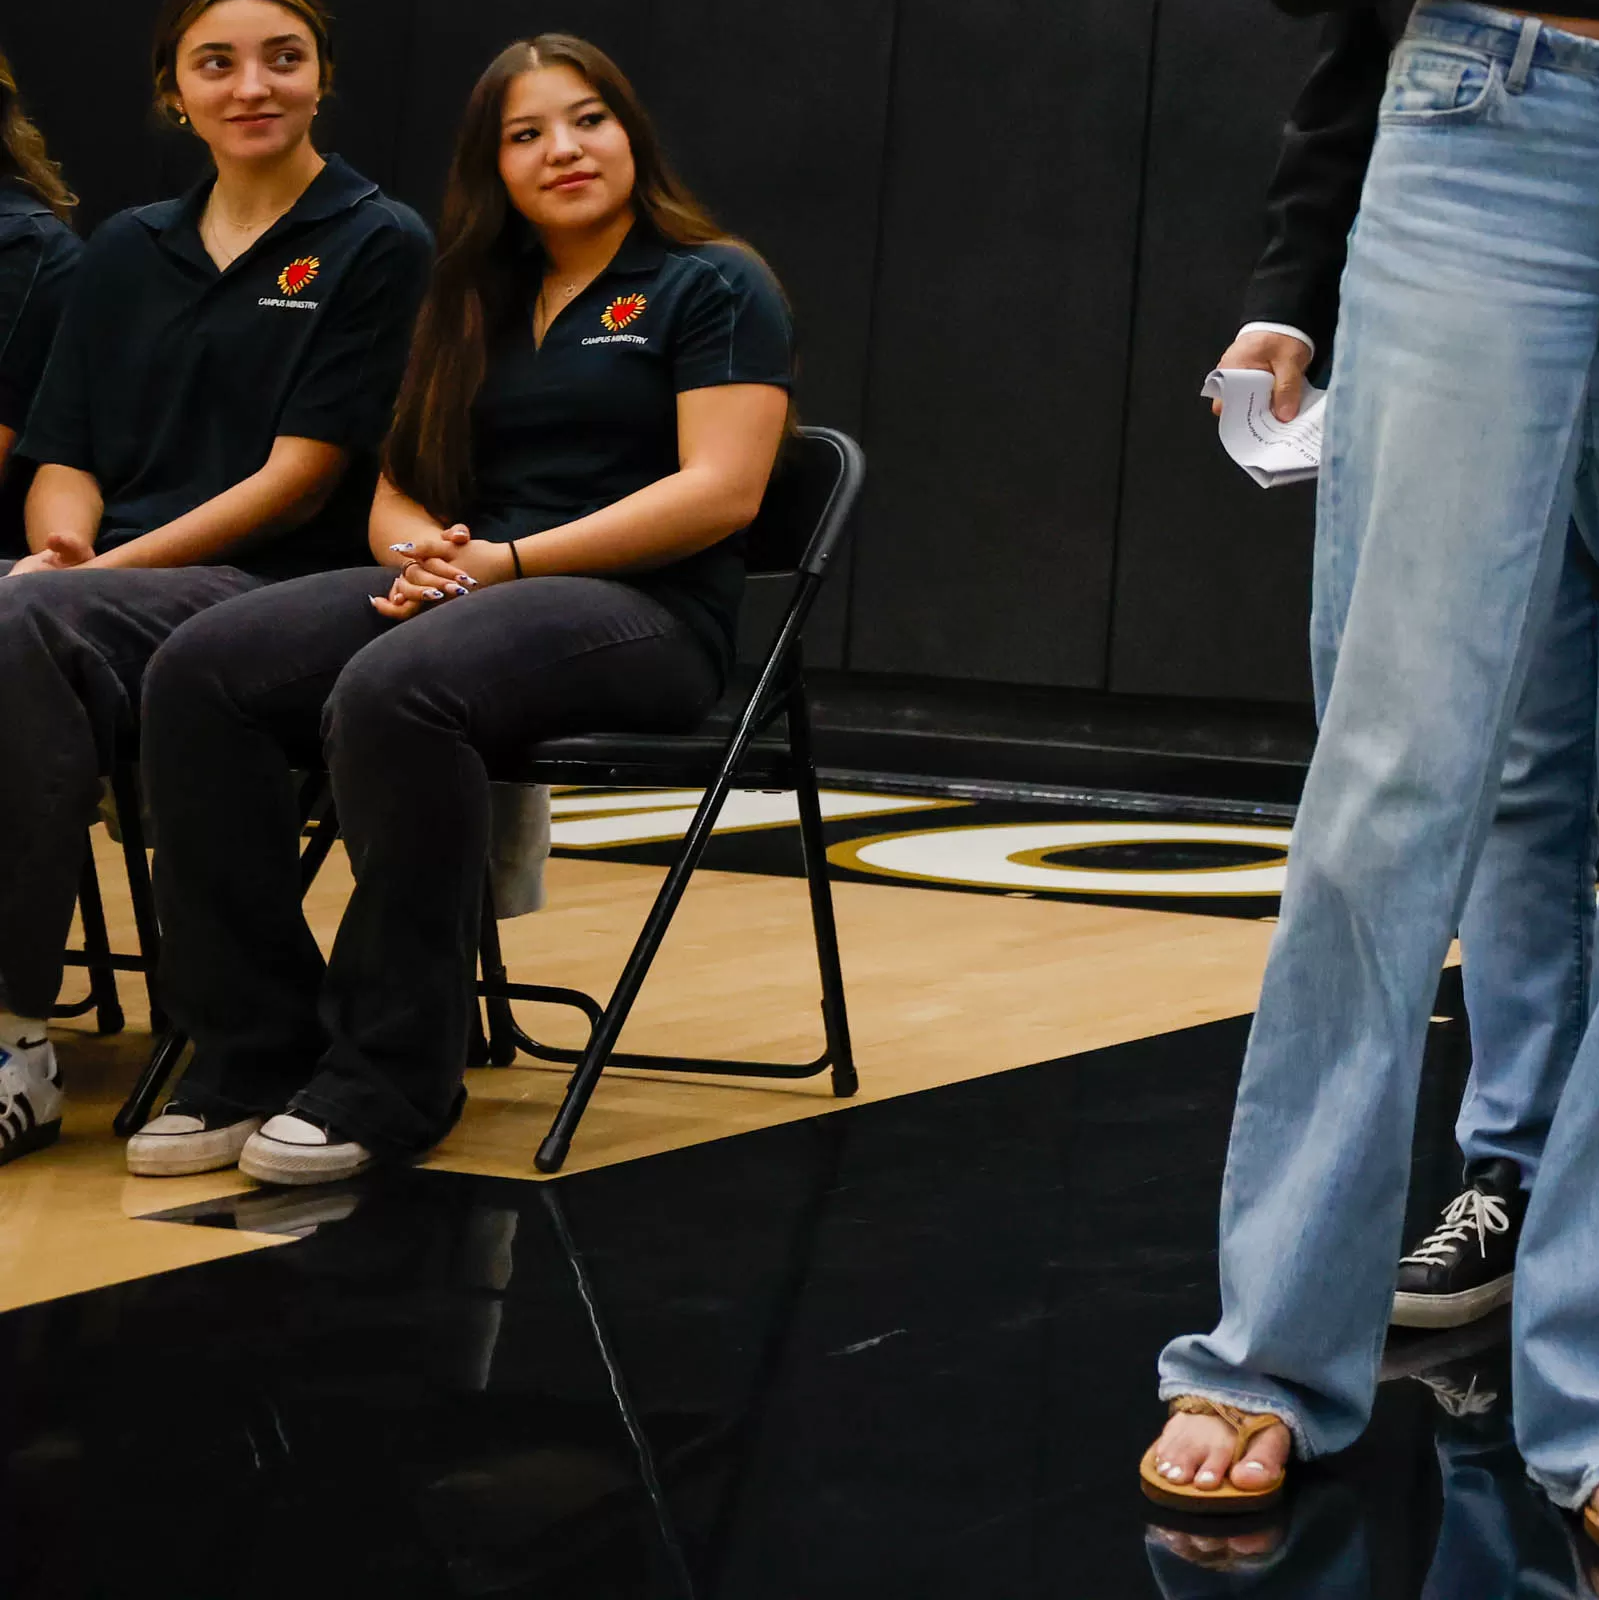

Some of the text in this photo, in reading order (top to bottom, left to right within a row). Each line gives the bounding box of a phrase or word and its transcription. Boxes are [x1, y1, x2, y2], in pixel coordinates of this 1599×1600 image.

[258, 298, 285, 307] CAMPUS
[581, 334, 648, 345] CAMPUS MINISTRY
